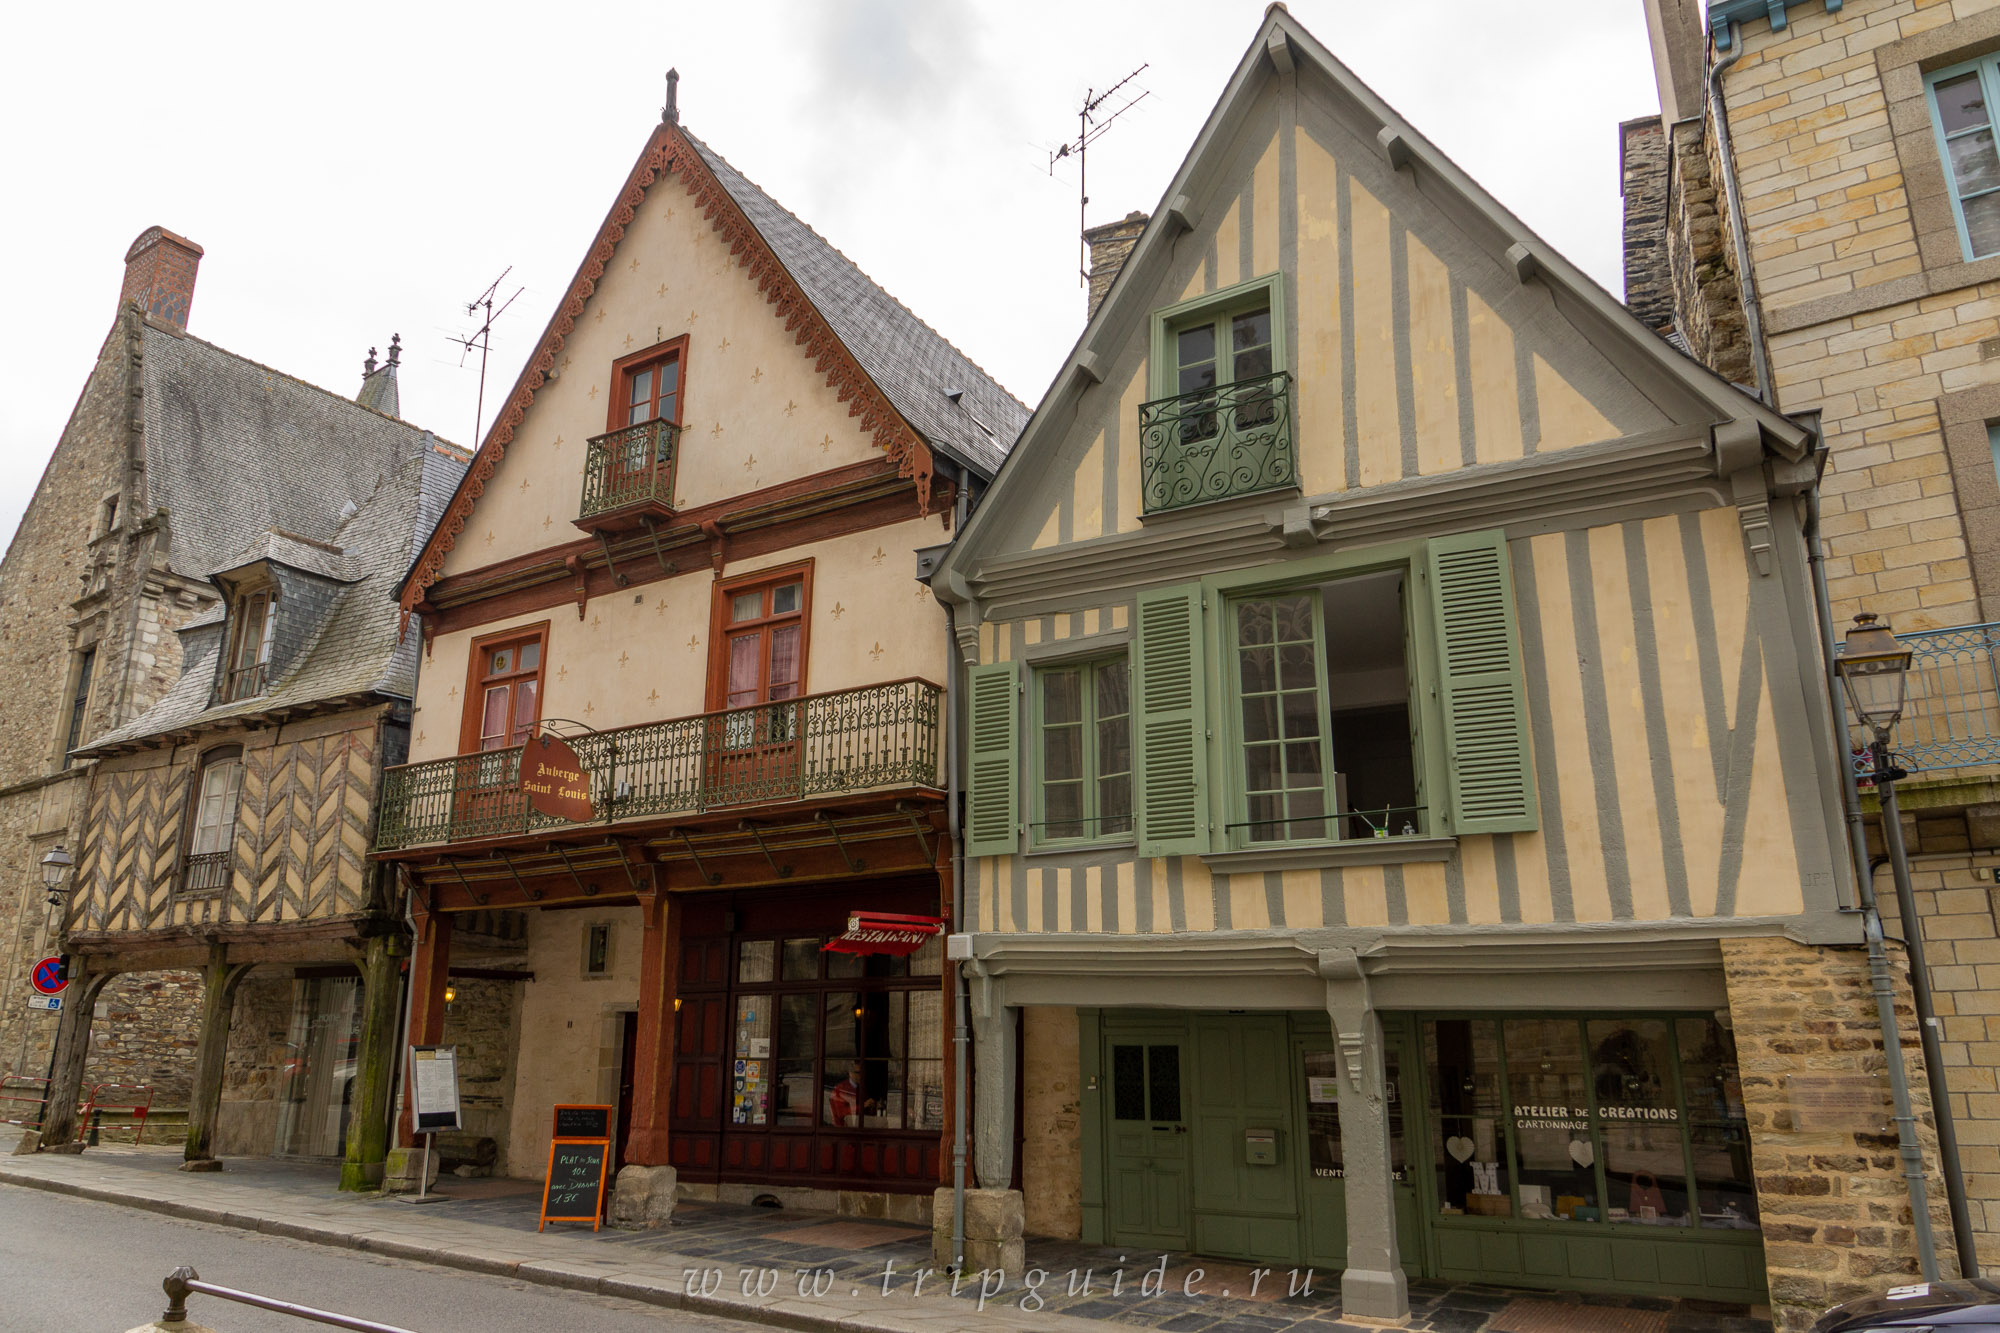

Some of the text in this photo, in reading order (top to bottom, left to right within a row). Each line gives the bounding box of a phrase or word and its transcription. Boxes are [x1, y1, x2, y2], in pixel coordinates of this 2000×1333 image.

[537, 762, 580, 783] Auberge
[523, 780, 587, 801] Saint Louis
[1514, 1105, 1678, 1120] ATELIER DE CREATIONS
[1517, 1119, 1589, 1130] CARTONNAGE
[1315, 1168, 1345, 1177] VENT
